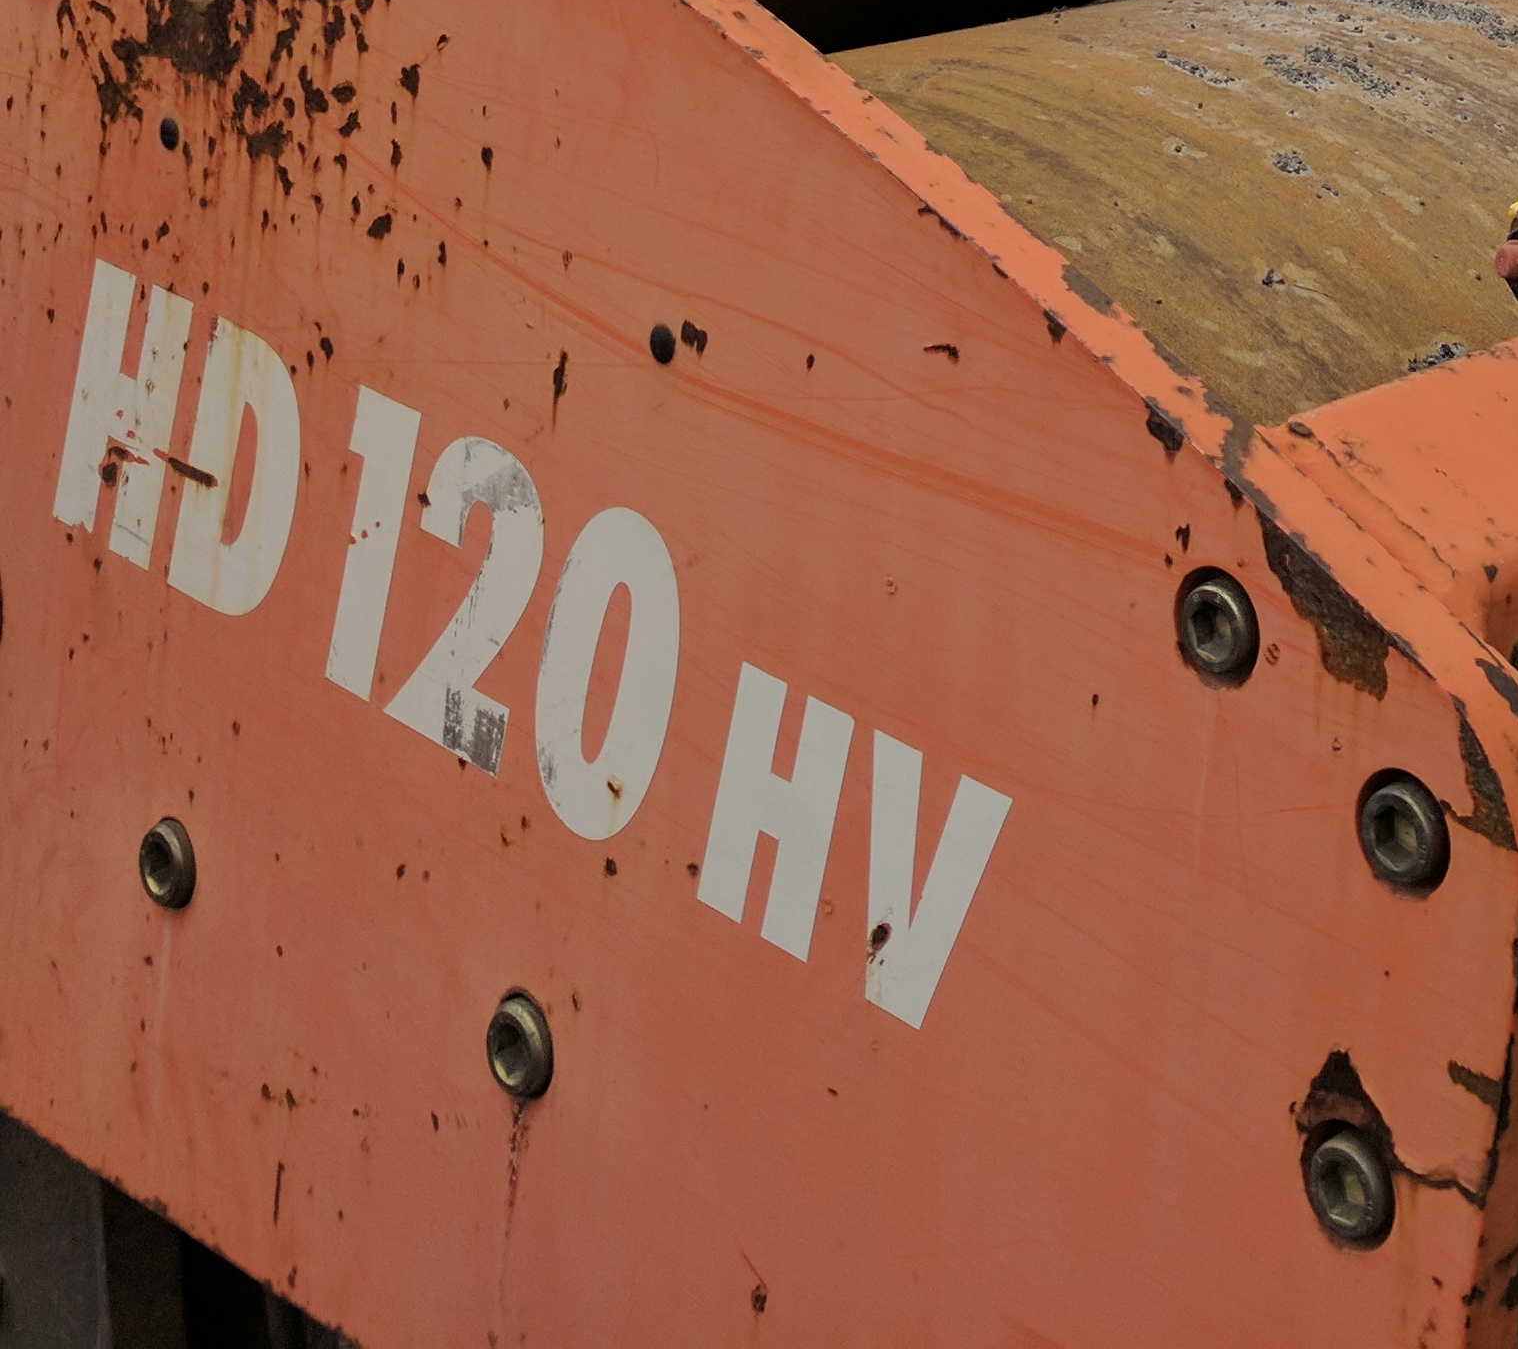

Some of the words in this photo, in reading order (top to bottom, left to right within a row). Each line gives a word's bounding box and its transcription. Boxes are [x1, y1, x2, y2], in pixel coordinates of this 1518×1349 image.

[52, 257, 302, 617] HD
[325, 386, 681, 841] 120
[696, 661, 1013, 1030] HV
